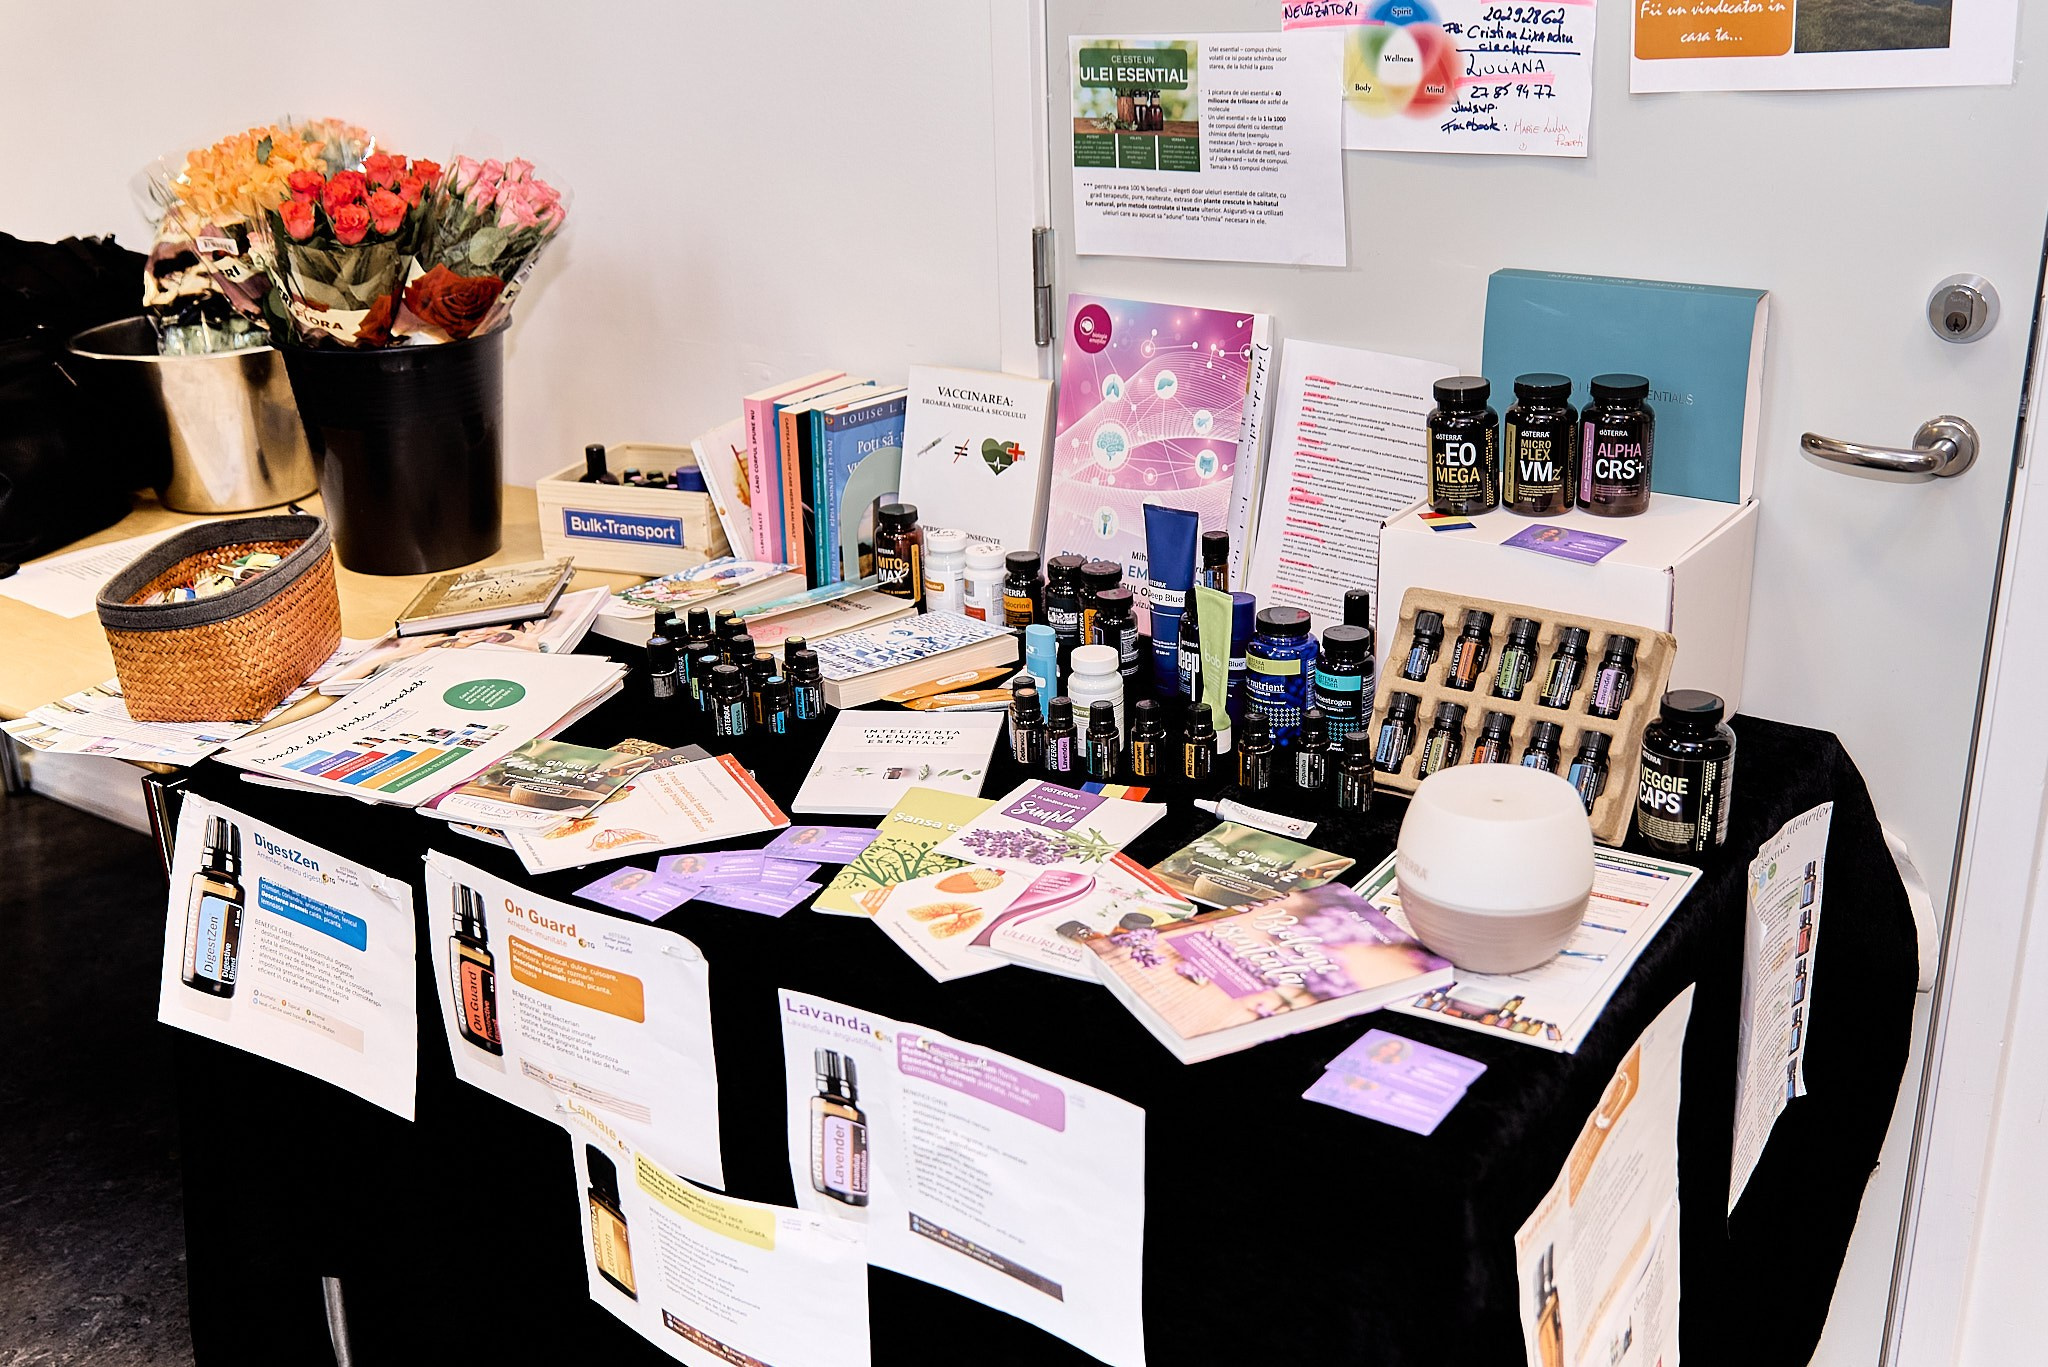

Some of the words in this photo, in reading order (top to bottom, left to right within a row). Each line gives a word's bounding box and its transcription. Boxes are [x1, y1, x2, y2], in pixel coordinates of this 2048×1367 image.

[1392, 8, 1411, 16] Spirit
[1667, 4, 1687, 16] un
[1681, 29, 1711, 44] casa
[1384, 54, 1413, 63] Wellness
[1081, 67, 1112, 81] ULEI
[1117, 68, 1188, 83] ESENTIAL
[1355, 84, 1372, 93] Body
[1426, 85, 1444, 93] Mind
[1471, 86, 1488, 98] 27
[1494, 83, 1512, 97] 85
[1516, 85, 1529, 98] 94
[1534, 85, 1555, 99] 77
[938, 386, 1014, 407] VACCINAREA:
[749, 409, 756, 420] NU
[842, 407, 883, 425] LOUISE
[922, 398, 951, 408] EROAREA
[992, 410, 1027, 419] SECOLULUI
[1521, 439, 1551, 449] MICRO
[1598, 443, 1641, 458] ALPHA
[1520, 448, 1550, 460] PLEX
[1436, 467, 1480, 483] MEGA
[570, 516, 675, 540] Bulk-Transport
[879, 568, 903, 583] MAX
[1165, 594, 1183, 603] Blue
[1250, 679, 1285, 692] nutrient
[1599, 674, 1612, 704] Lavender
[735, 709, 743, 734] Cypress
[545, 760, 587, 770] ghidul
[1641, 763, 1688, 794] VEGGIE
[1640, 781, 1680, 814] CAPS
[1011, 800, 1076, 825] Simplu
[948, 823, 963, 832] ta
[254, 832, 319, 872] DigestZen
[1237, 850, 1282, 868] ghidul
[1264, 868, 1278, 878] la
[505, 898, 523, 918] On
[528, 909, 576, 938] Guard
[204, 916, 218, 973] DigestZen
[222, 943, 231, 978] Digestive
[468, 970, 478, 1011] Guard
[474, 1014, 482, 1031] On
[785, 997, 871, 1035] Lavanda
[832, 1124, 846, 1186] Lavender
